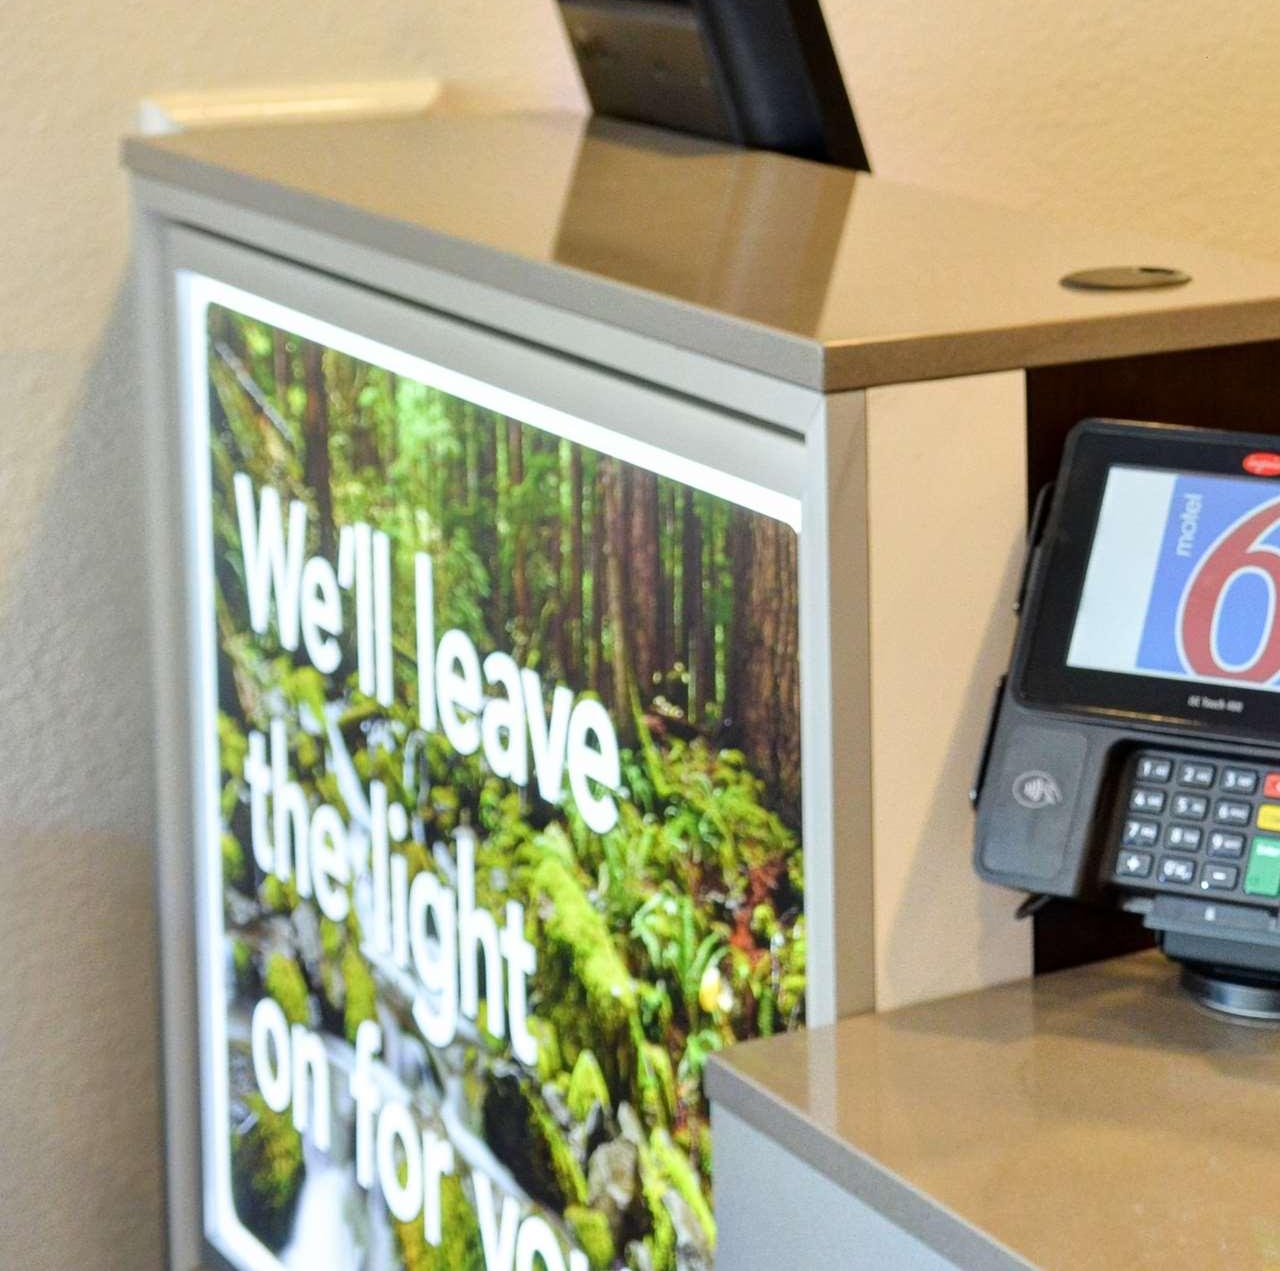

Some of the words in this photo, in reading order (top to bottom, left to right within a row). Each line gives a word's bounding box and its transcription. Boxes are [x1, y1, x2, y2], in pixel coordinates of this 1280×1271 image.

[232, 471, 395, 707] We'll
[414, 551, 623, 834] leave
[1175, 492, 1203, 558] motel
[242, 718, 350, 923] the
[360, 781, 537, 1066] light
[251, 997, 331, 1152] on
[349, 1018, 453, 1246] for
